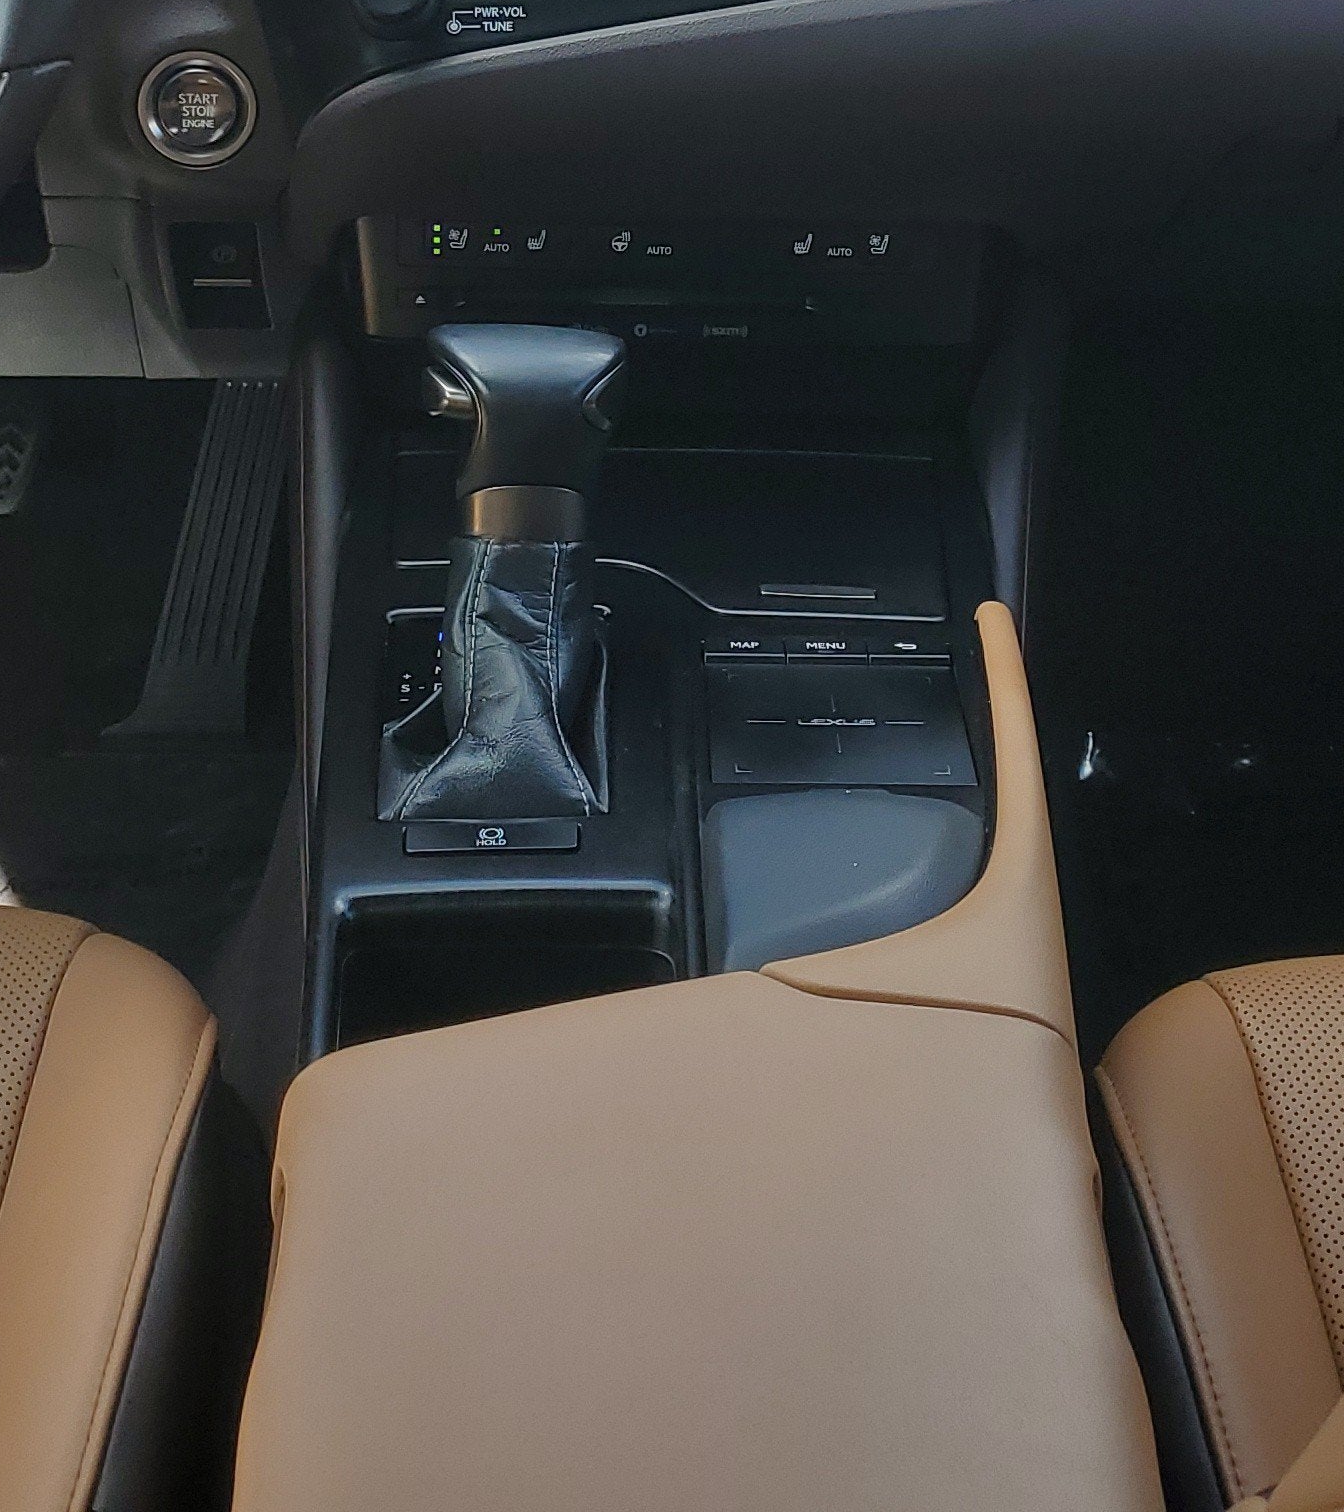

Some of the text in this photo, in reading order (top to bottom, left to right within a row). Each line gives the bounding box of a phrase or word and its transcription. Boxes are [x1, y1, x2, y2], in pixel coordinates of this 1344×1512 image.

[482, 20, 514, 32] TUNE
[177, 93, 219, 105] START
[181, 105, 216, 117] STOP
[182, 119, 215, 129] ENGINE
[484, 242, 510, 253] AUTO
[646, 245, 673, 256] AUTO
[827, 246, 853, 258] AUTO
[729, 641, 760, 650] MAP
[805, 641, 846, 651] MENU
[797, 718, 877, 726] LEXUS
[476, 838, 507, 847] HOLD
